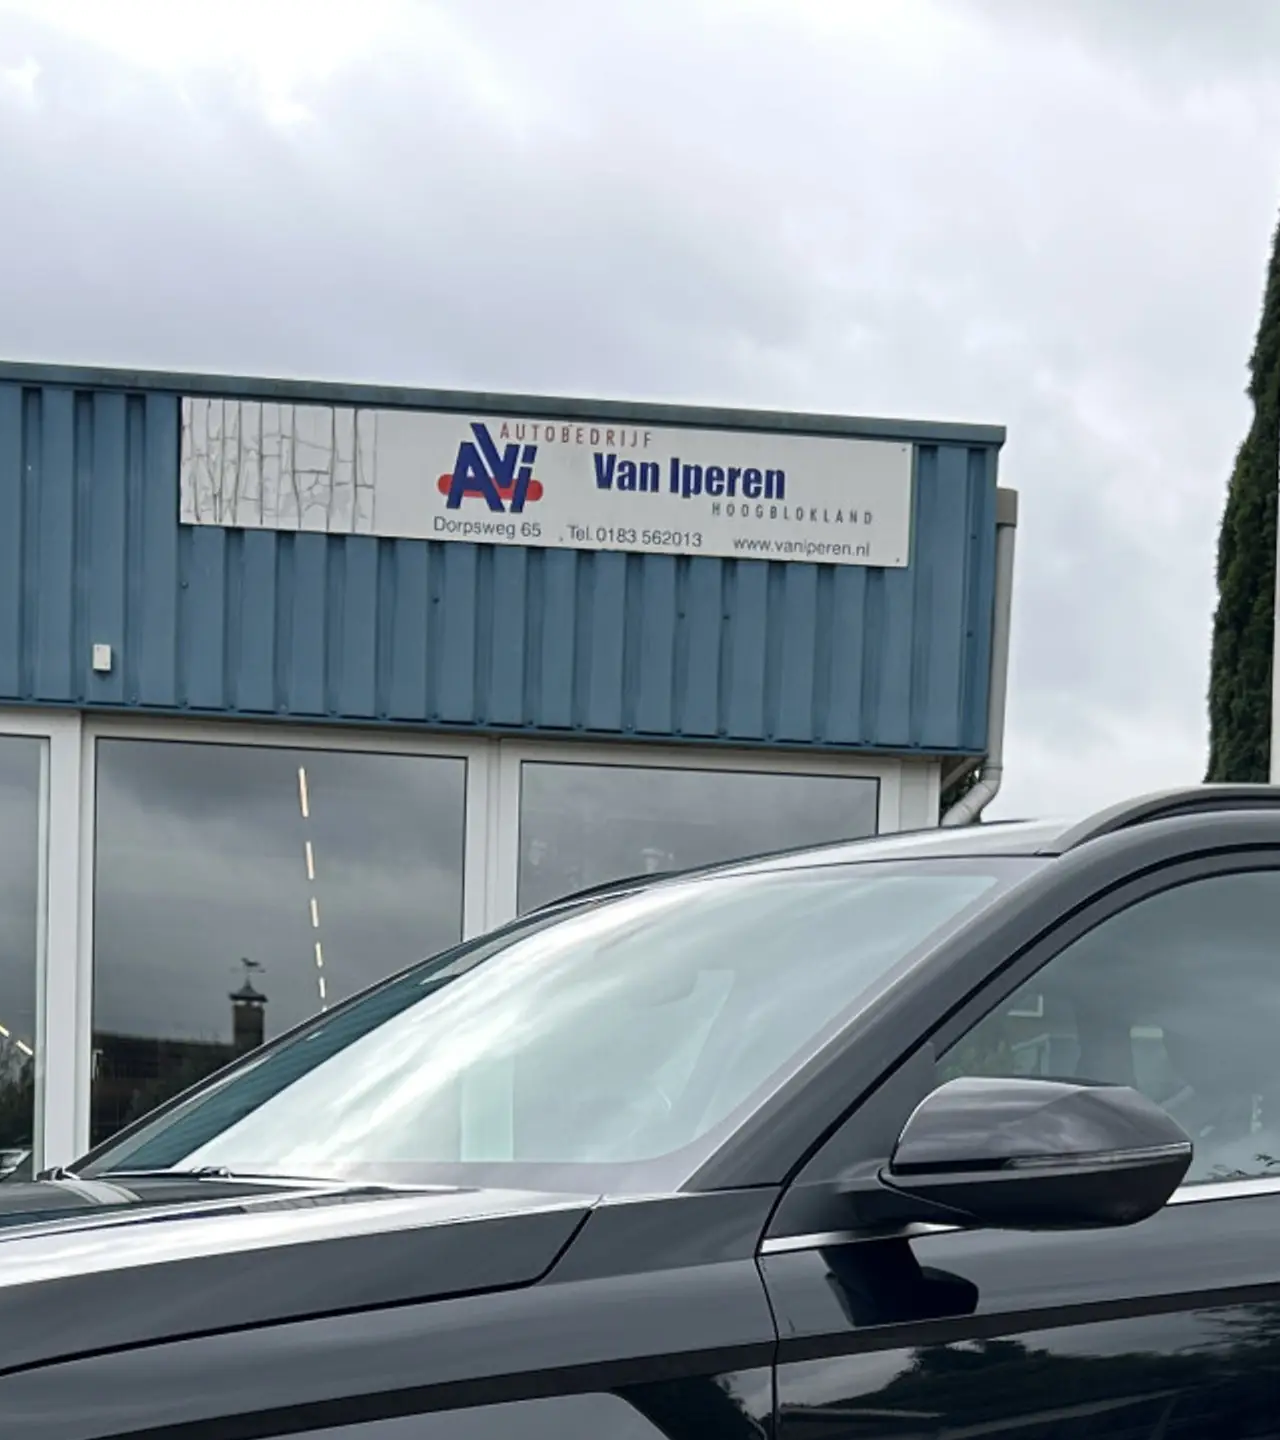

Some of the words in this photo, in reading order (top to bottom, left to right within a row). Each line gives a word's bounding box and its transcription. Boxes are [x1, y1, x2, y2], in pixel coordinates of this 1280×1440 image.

[500, 422, 652, 449] AUTOBEDRIJF
[593, 452, 660, 493] Van
[670, 457, 785, 500] Iperen
[712, 502, 873, 525] HOOGBLOKLAND
[433, 516, 516, 539] Dorpsweg
[521, 522, 542, 537] 65
[596, 527, 637, 544] 0183
[641, 530, 703, 548] 562013
[733, 537, 870, 557] www.vaniperen.nl
